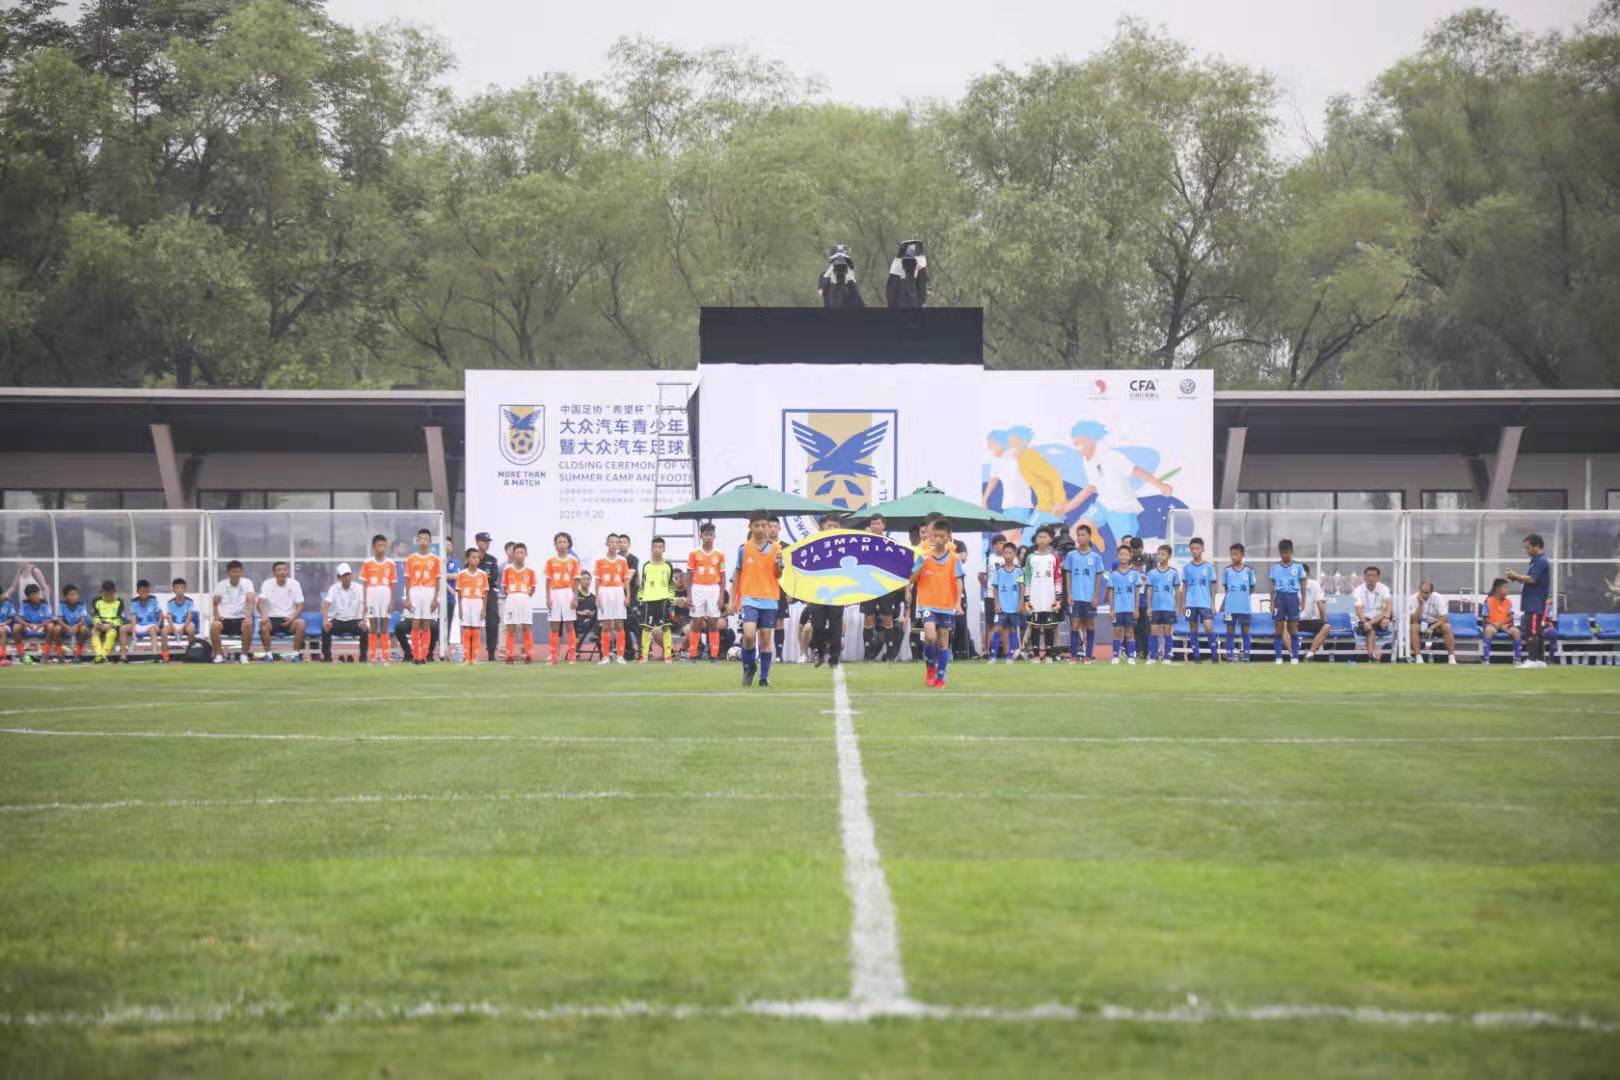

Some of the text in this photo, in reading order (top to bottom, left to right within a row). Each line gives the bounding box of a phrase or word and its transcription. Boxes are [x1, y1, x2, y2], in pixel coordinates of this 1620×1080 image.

[1129, 380, 1156, 392] CFA
[560, 418, 685, 435] 大众汽车青少年
[560, 438, 690, 456] 暨大众汽车足球
[558, 460, 603, 470] CLOSING
[664, 460, 677, 470] OF
[498, 470, 546, 478] MORE THAN
[559, 473, 603, 482] SUMMER
[606, 473, 634, 482] CAMP
